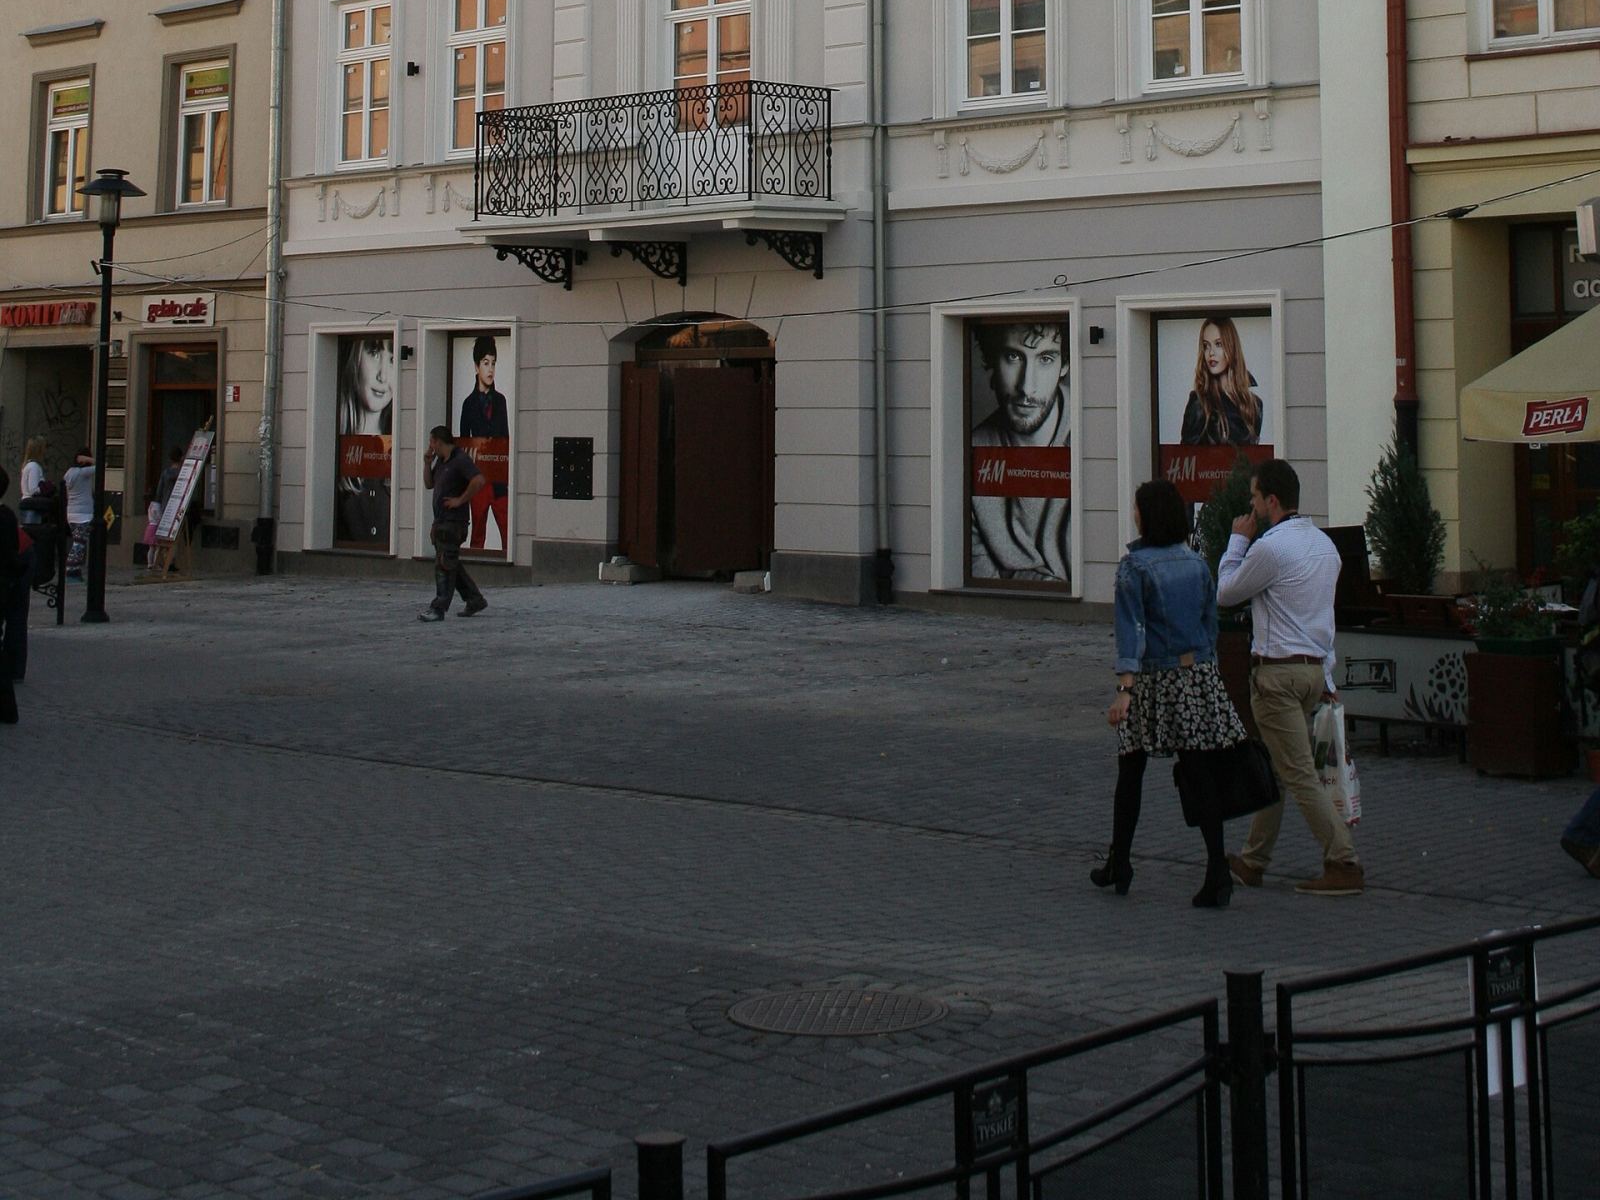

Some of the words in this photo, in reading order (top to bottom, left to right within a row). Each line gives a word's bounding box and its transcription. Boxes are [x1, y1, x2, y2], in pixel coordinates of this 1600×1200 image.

[147, 299, 183, 323] gelato
[183, 297, 208, 317] cafe
[1528, 405, 1583, 429] PERŁA
[977, 459, 1006, 484] H&M
[1007, 468, 1040, 479] WKRÓTCE
[1167, 455, 1197, 483] H&M
[1491, 977, 1521, 996] TYSKIE
[977, 1115, 1013, 1142] TYSKIE
